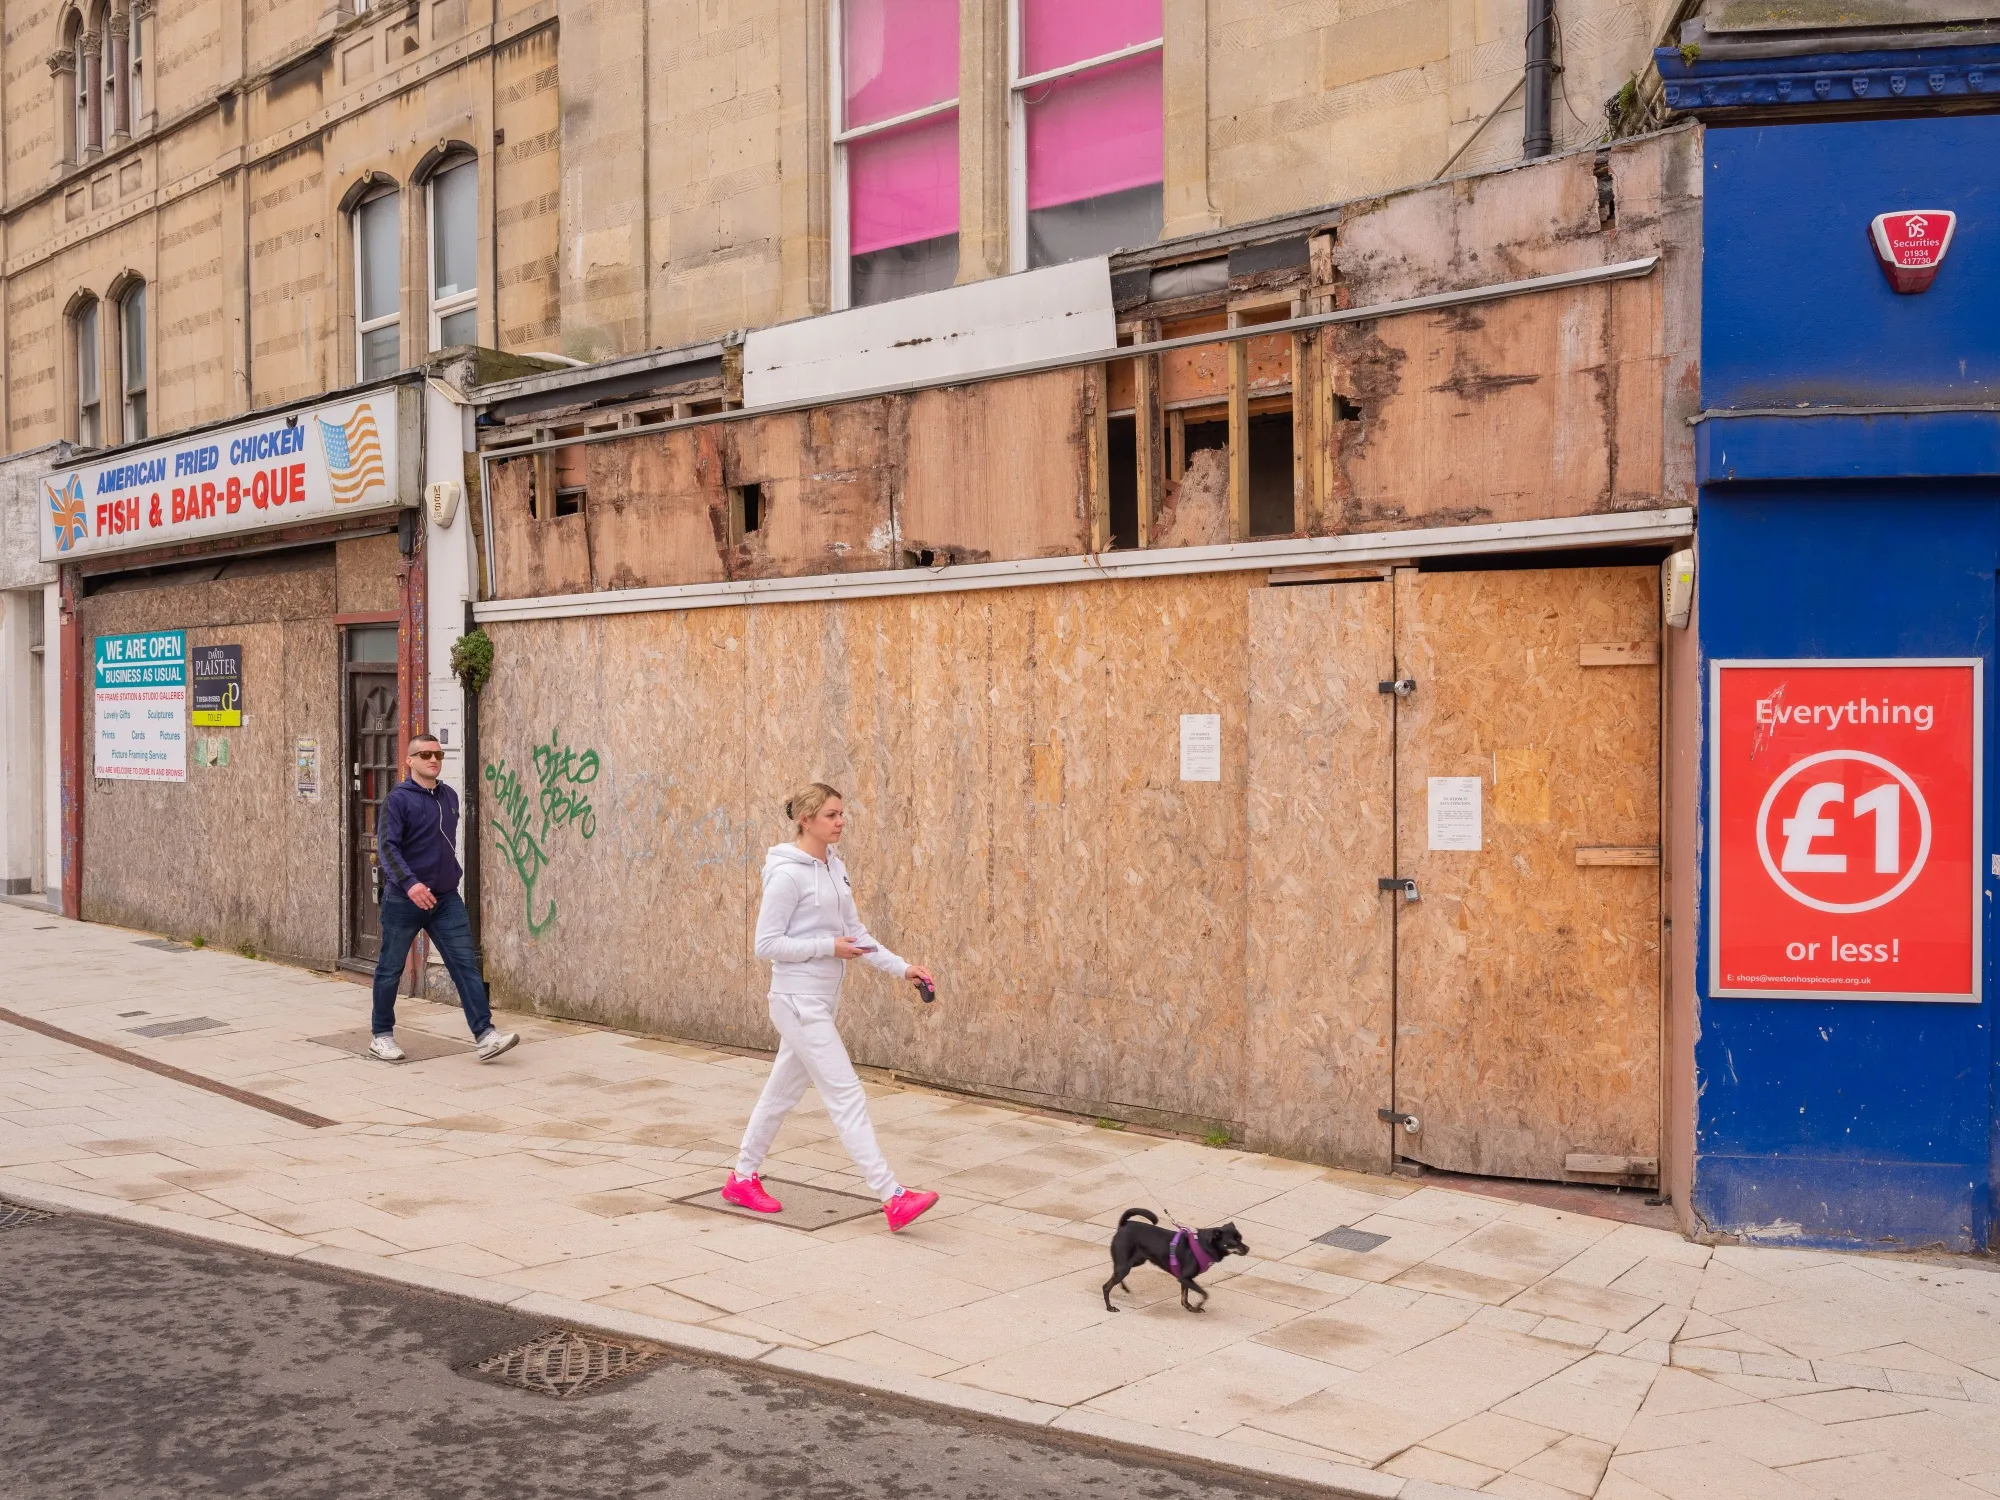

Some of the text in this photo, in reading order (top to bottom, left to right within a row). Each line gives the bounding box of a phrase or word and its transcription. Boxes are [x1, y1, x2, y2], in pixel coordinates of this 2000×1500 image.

[1908, 223, 1925, 238] DS
[1893, 238, 1940, 248] Securities
[96, 425, 305, 496] AMERICAN FRIED CHICKEN
[96, 463, 306, 537] FISH & BAR-B-QUE
[105, 635, 181, 660] WE ARE OPEN
[208, 650, 224, 659] DAVID
[195, 659, 237, 676] PLAISTER
[105, 667, 182, 684] BUSINESS AS USUAL
[96, 691, 184, 701] THE FRAME STATION & STUDIO GALLERIES
[103, 709, 131, 721] Lovely Gifts
[147, 709, 174, 721] Sculptures
[208, 713, 222, 722] TO LET
[1755, 697, 1934, 731] Everything
[102, 730, 116, 740] Prints
[131, 730, 146, 740] Cards
[159, 730, 181, 741] Pictures
[111, 749, 167, 761] Picture Framing Service
[96, 766, 104, 774] YOU
[105, 766, 113, 774] ARE
[113, 766, 132, 774] WELCOME
[132, 767, 138, 775] TO
[151, 768, 156, 776] IN
[1781, 781, 1901, 874] £1
[1785, 935, 1899, 963] or less!
[1727, 974, 1872, 986] E: shops@westonhospicecare.org.uk
